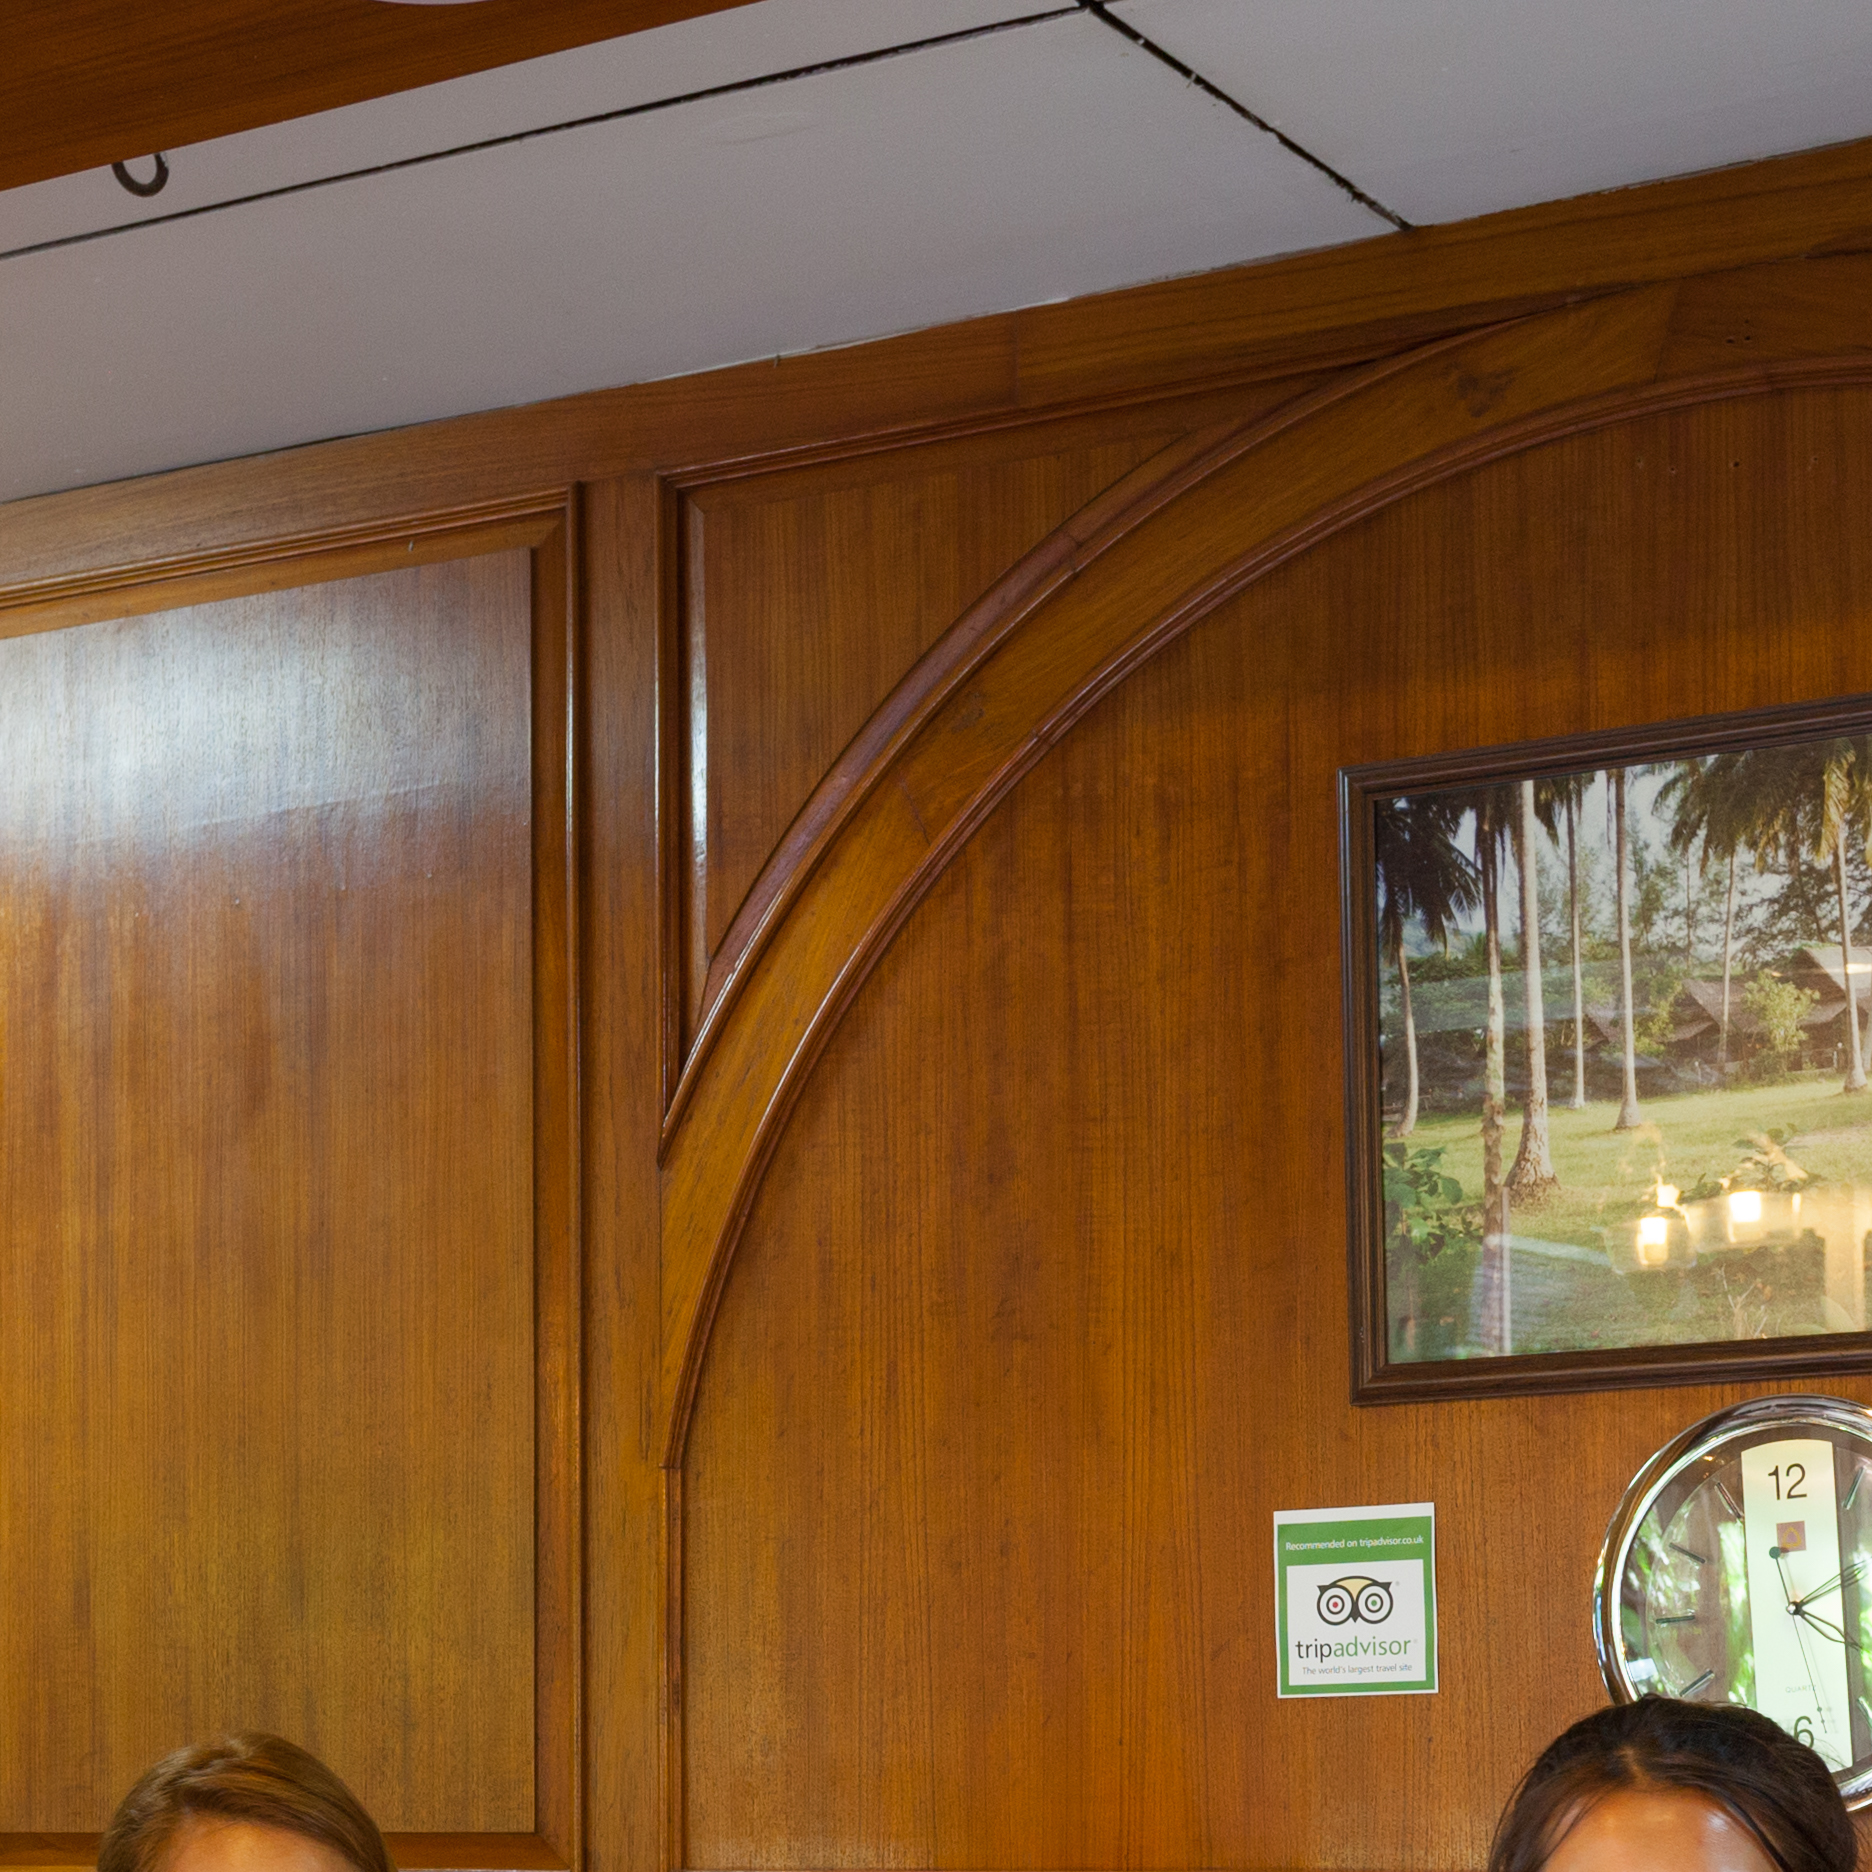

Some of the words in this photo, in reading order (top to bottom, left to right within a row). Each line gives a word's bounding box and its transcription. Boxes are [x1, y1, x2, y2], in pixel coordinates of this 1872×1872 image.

[1767, 1463, 1808, 1500] 12
[1285, 1538, 1345, 1551] Recommended
[1347, 1539, 1358, 1548] on
[1359, 1534, 1424, 1549] tripadvisor.co.uk
[1295, 1635, 1411, 1663] tripadvisor
[1302, 1666, 1316, 1675] The
[1318, 1665, 1346, 1674] world's
[1347, 1664, 1374, 1675] largest
[1376, 1663, 1397, 1672] travel
[1399, 1663, 1412, 1671] site
[1793, 1715, 1815, 1749] 6
